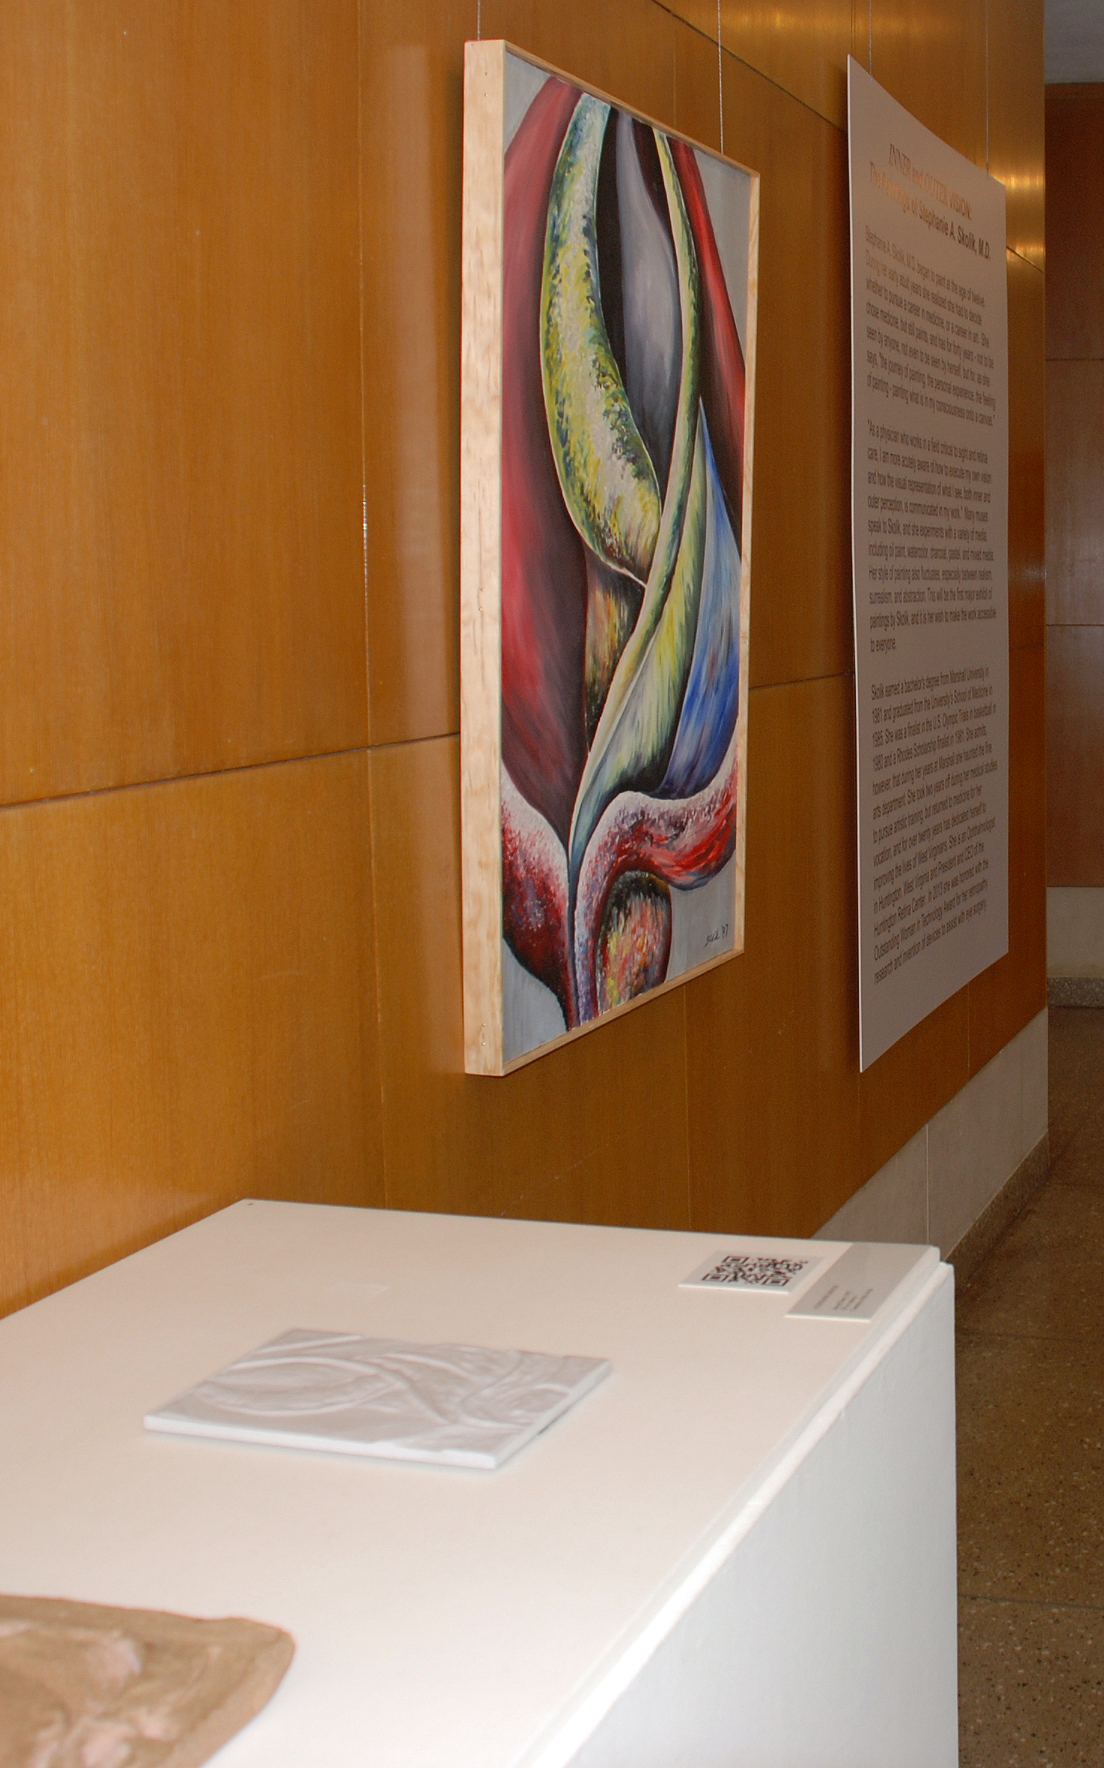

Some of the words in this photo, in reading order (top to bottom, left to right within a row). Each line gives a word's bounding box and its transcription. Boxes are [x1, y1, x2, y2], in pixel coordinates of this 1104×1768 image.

[870, 161, 880, 188] The
[911, 197, 918, 215] of
[919, 198, 948, 236] Stephanie
[949, 220, 955, 241] A.
[957, 225, 977, 255] Skolik,
[979, 238, 991, 260] M.D.
[925, 172, 947, 206] OUTER
